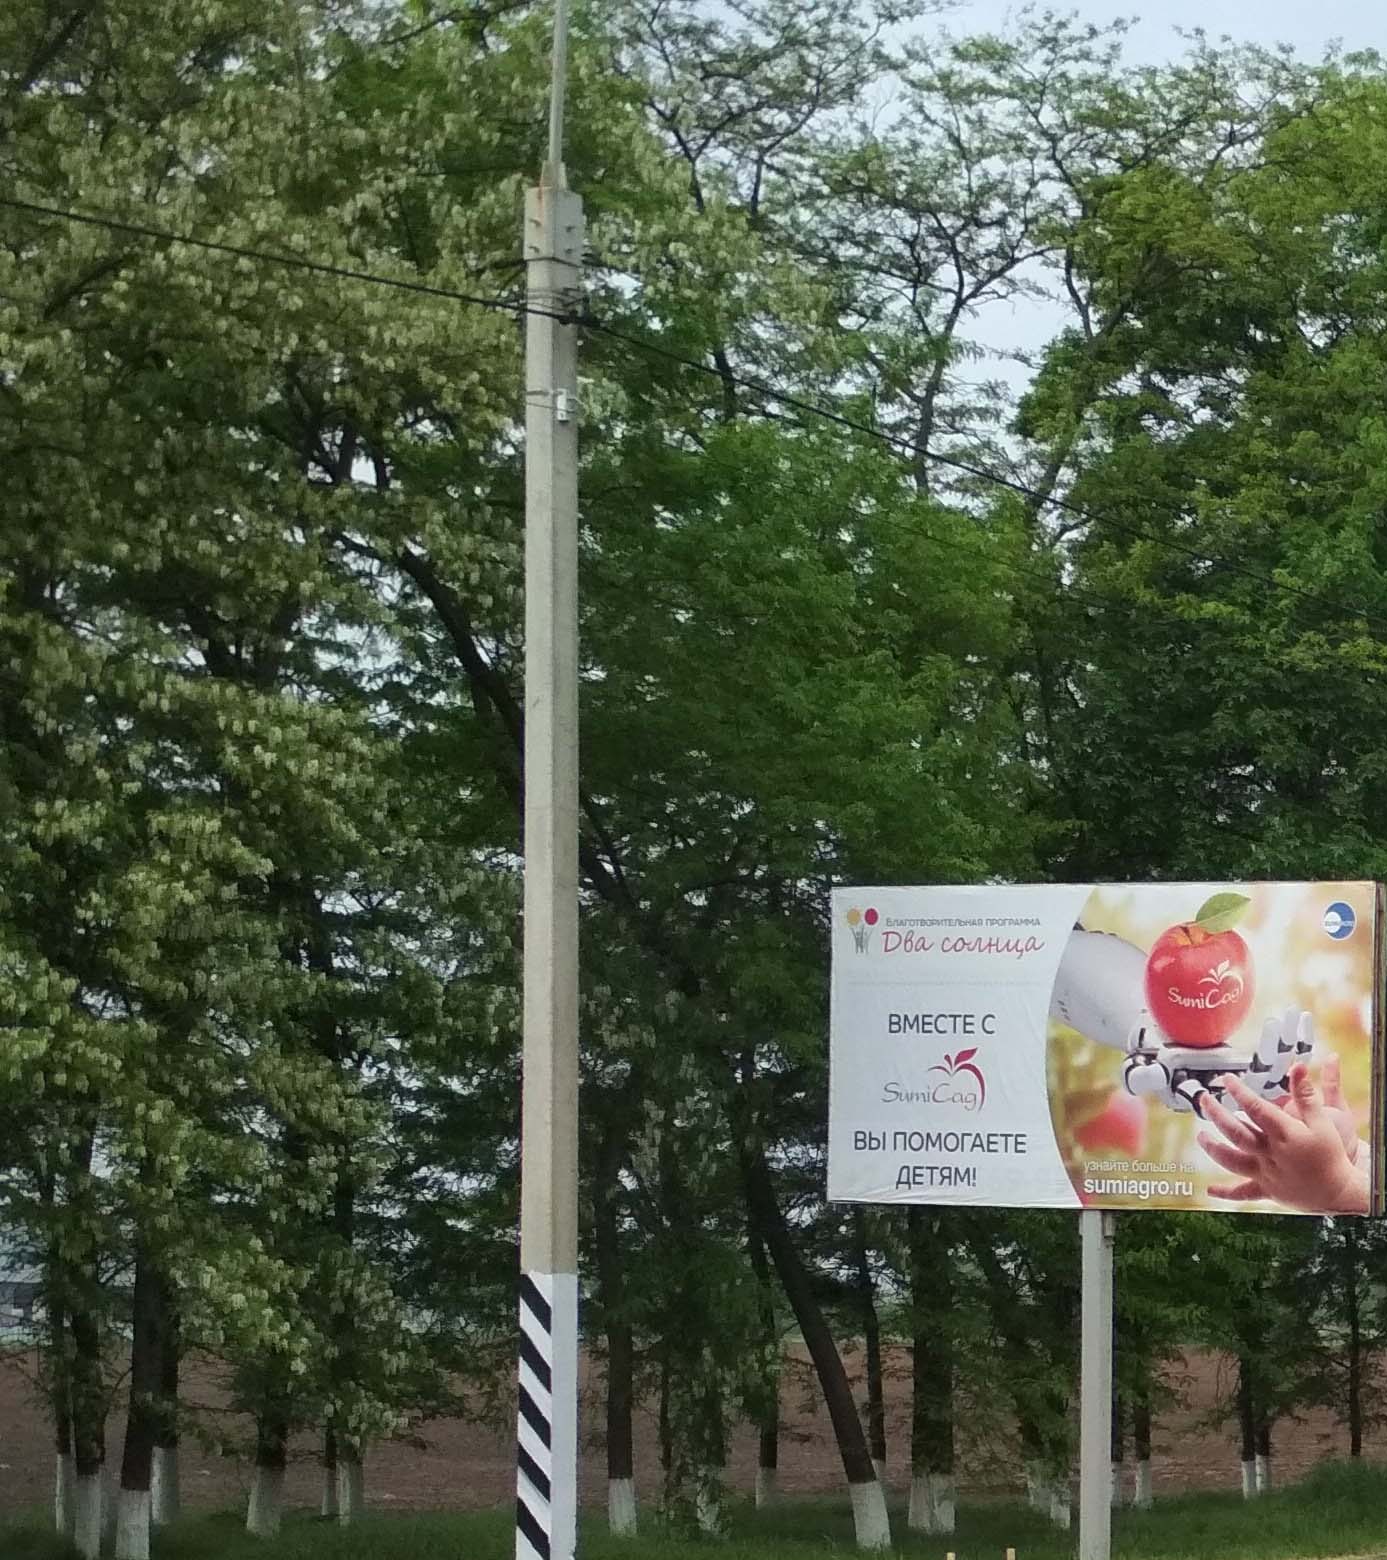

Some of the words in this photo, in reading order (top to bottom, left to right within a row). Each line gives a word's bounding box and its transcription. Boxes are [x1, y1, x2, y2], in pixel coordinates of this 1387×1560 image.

[881, 929, 935, 953] Два
[941, 935, 1045, 959] солнца
[888, 1013, 975, 1034] ВМЕСТЕ
[981, 1014, 996, 1034] С
[881, 1081, 978, 1112] SumiCag
[853, 1130, 887, 1151] ВЫ
[893, 1131, 1028, 1154] ПОМОГАЕТЕ
[895, 1165, 978, 1190] ДЕТЯМ!
[1083, 1160, 1129, 1173] узнайте
[1131, 1160, 1177, 1173] больше
[1083, 1176, 1194, 1200] sumiagro.ru
